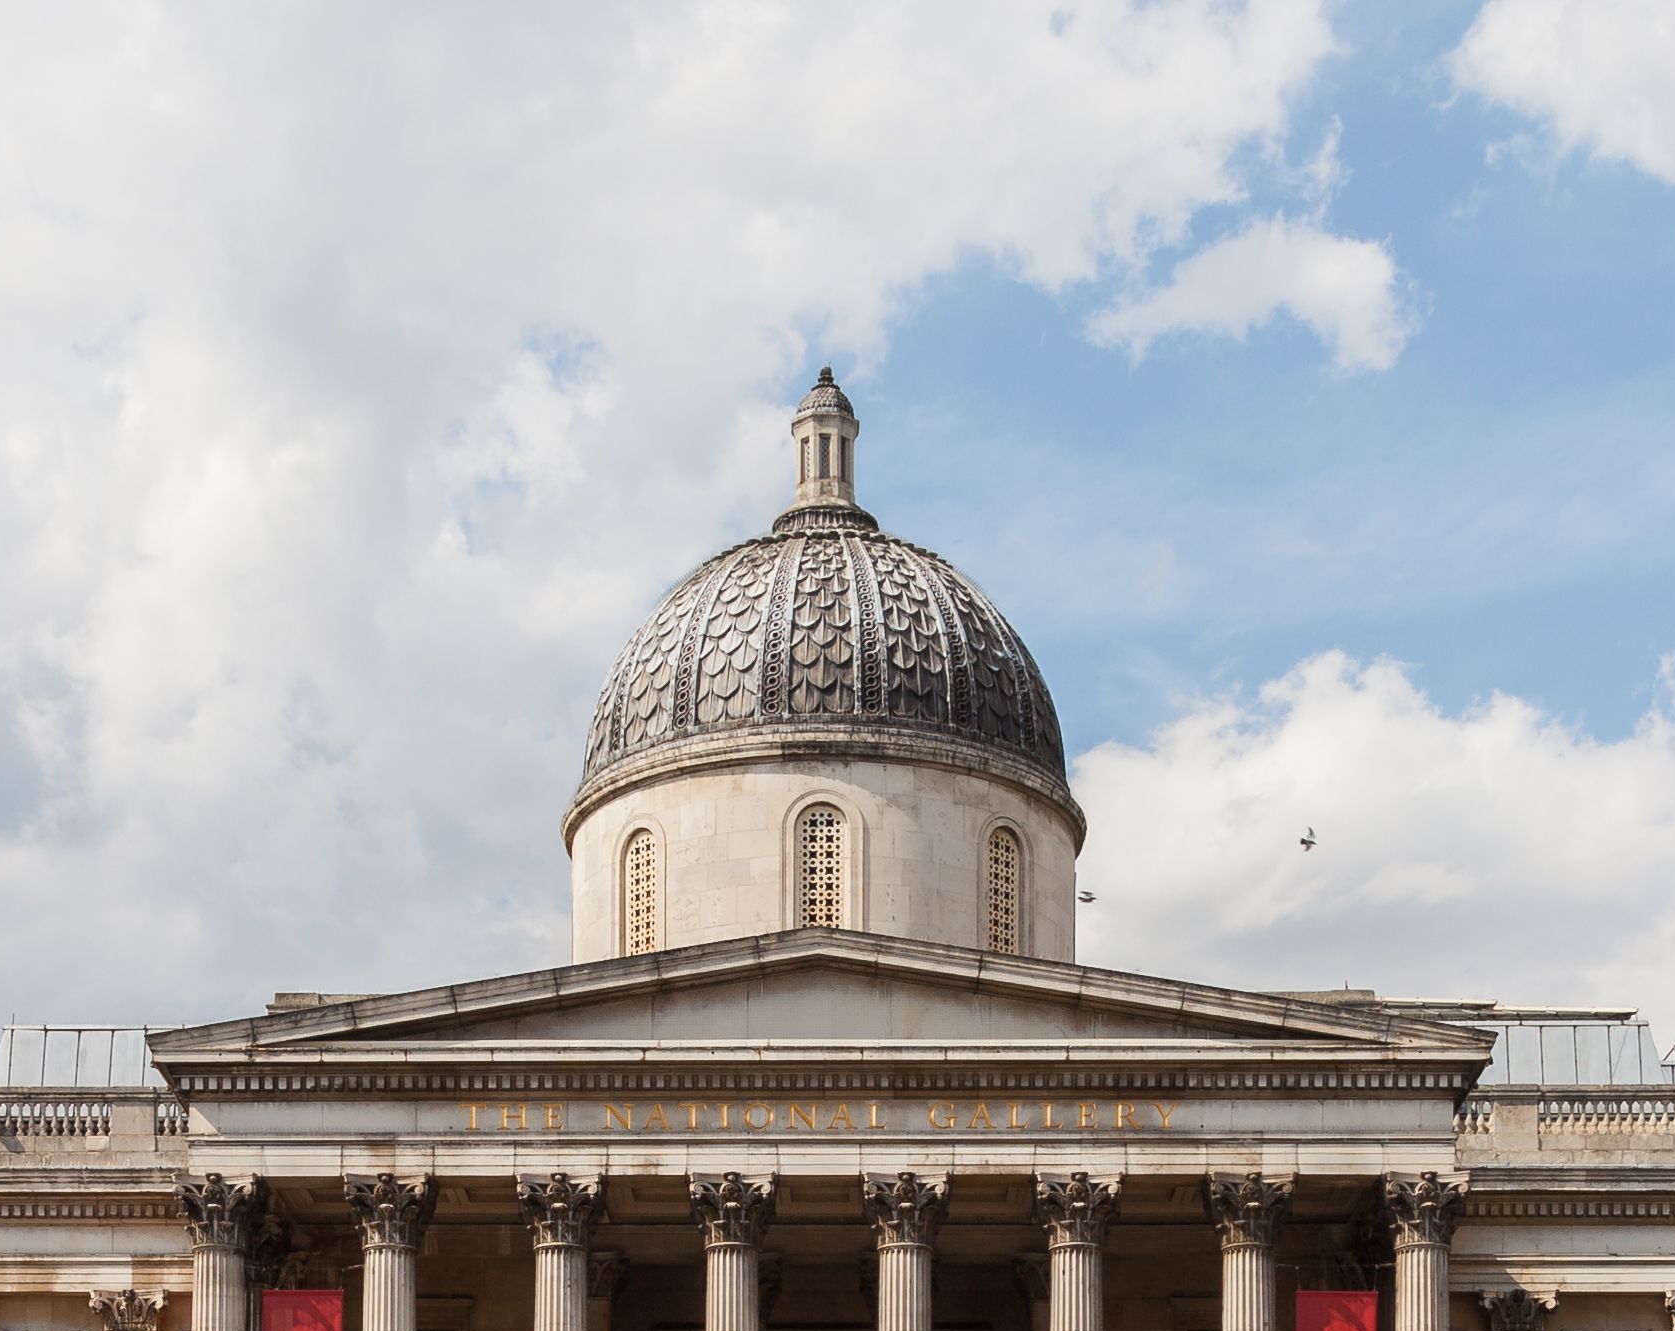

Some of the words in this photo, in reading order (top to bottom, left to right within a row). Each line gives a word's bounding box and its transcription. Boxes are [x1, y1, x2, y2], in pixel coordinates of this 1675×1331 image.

[458, 1101, 564, 1131] THE
[603, 1101, 887, 1131] NATIONAL
[928, 1100, 1179, 1130] GALLERY
